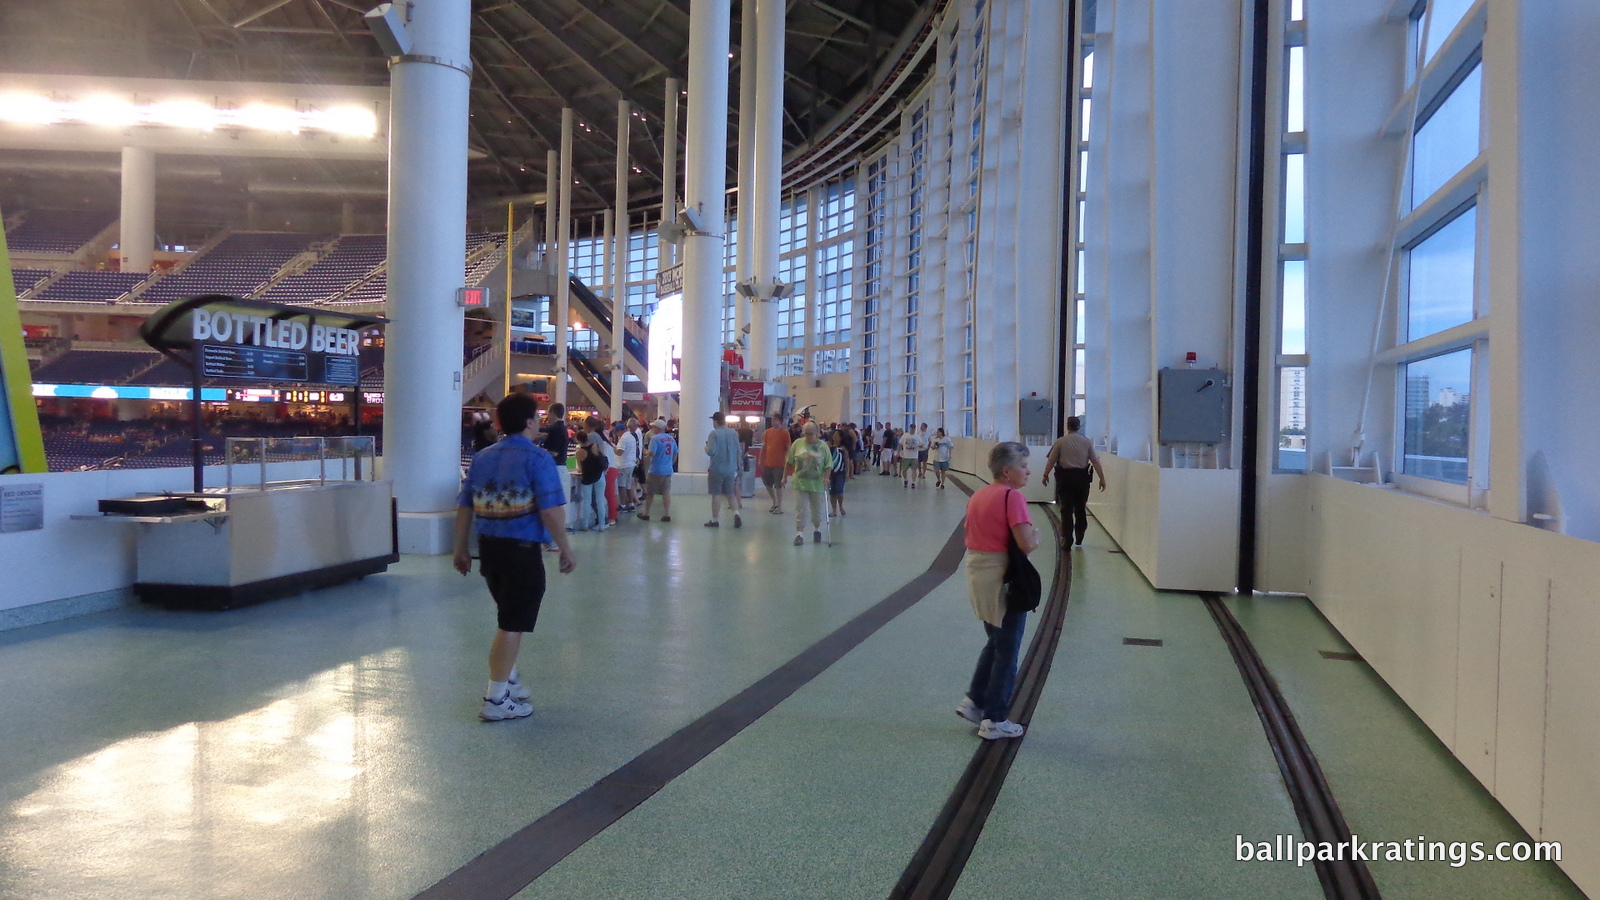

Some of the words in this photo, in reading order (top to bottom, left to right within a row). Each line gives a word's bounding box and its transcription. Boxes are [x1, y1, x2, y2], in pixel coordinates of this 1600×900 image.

[465, 290, 482, 304] EXIT
[192, 307, 308, 350] BOTTLED
[311, 324, 360, 356] BEER
[665, 443, 672, 456] 3
